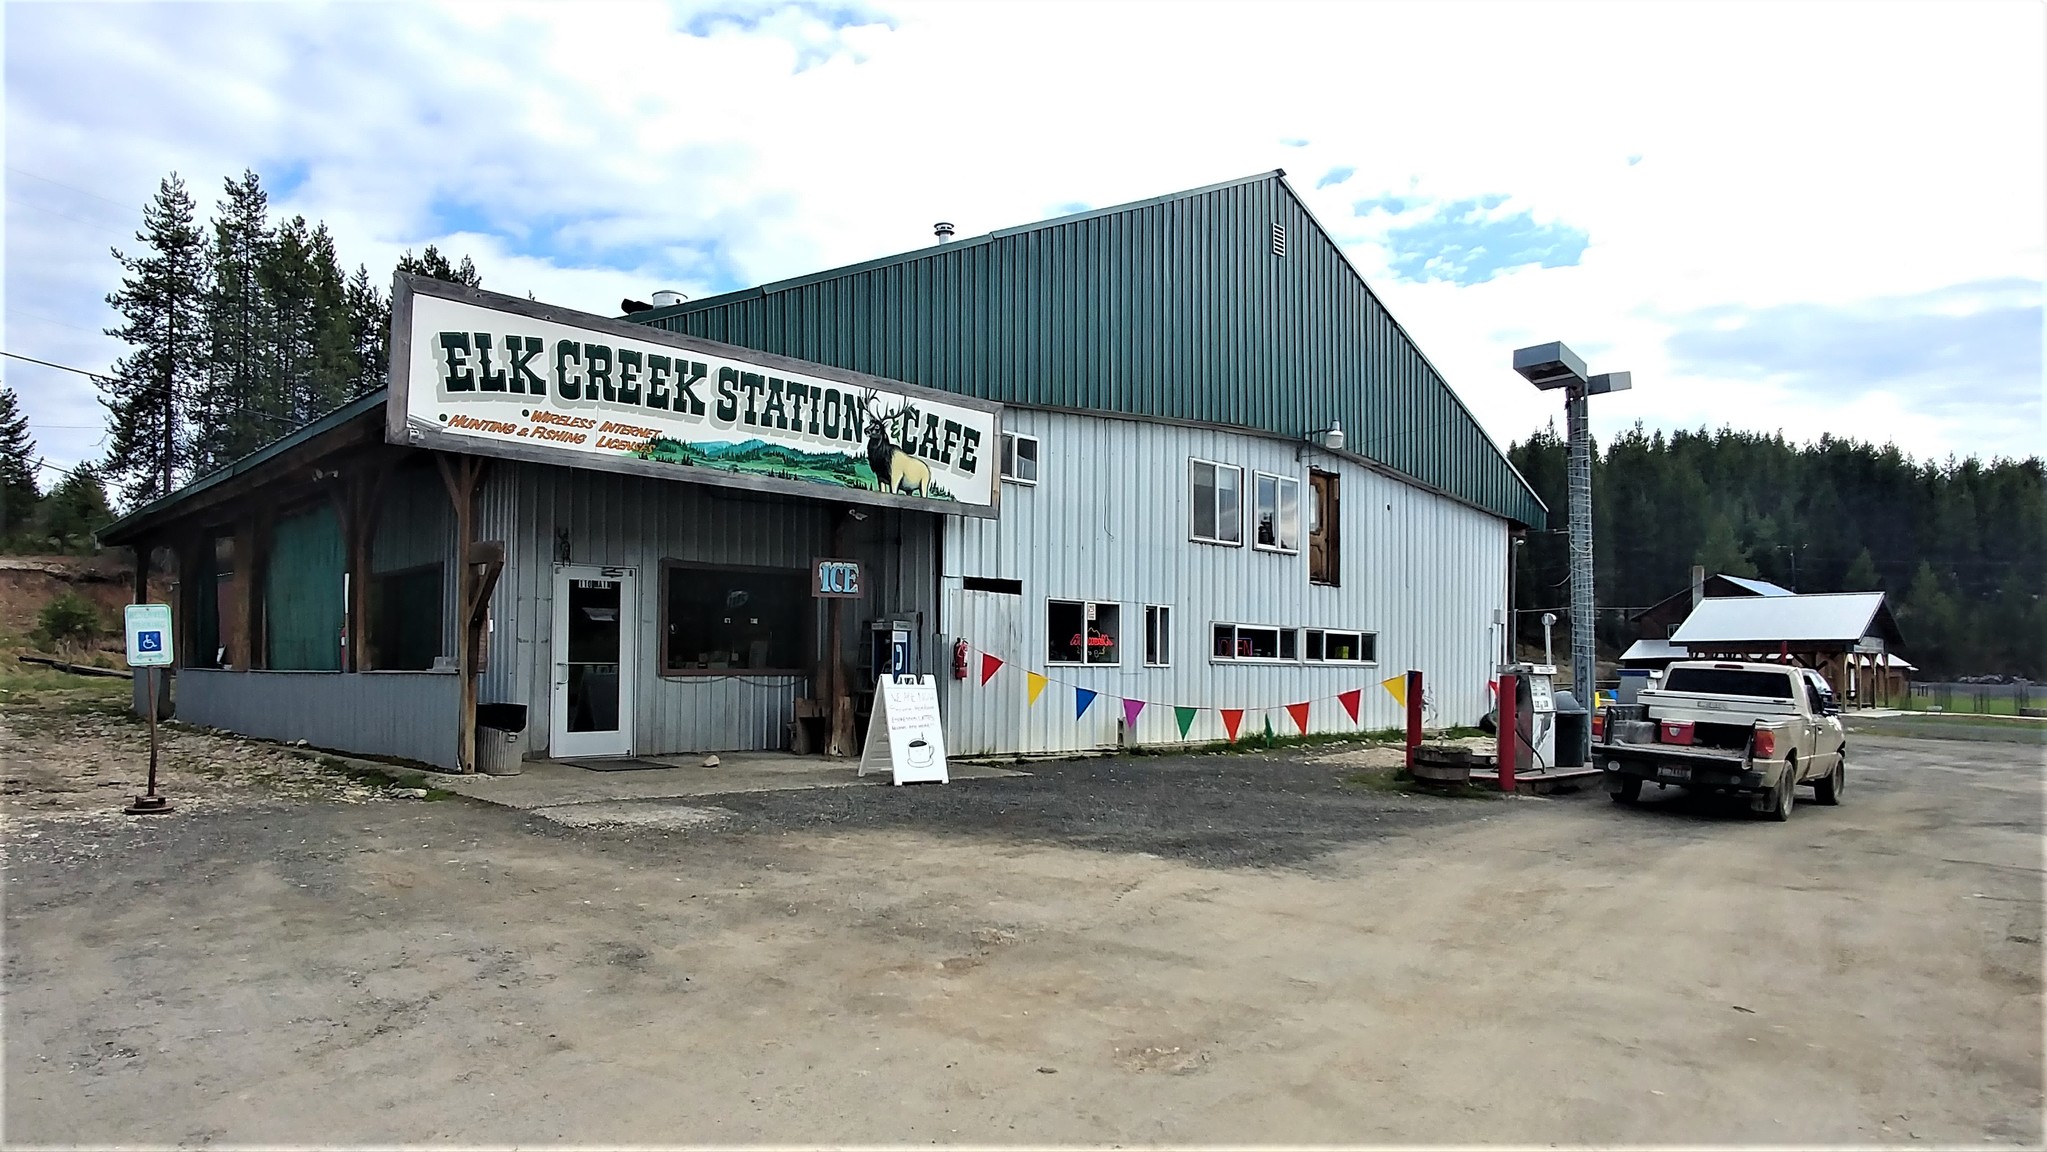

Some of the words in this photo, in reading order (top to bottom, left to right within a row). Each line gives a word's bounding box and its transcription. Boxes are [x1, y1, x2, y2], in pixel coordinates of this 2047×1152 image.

[439, 332, 547, 396] ELK
[555, 339, 707, 417] CREEK
[717, 366, 864, 444] STATION
[902, 406, 981, 474] CAFE
[448, 414, 518, 435] HUNTING
[517, 427, 530, 438] &
[529, 426, 588, 445] FISHING
[596, 435, 657, 454] LICENSES
[530, 409, 597, 430] WIRELESS
[598, 421, 662, 439] INTERNET
[819, 561, 860, 594] ICE
